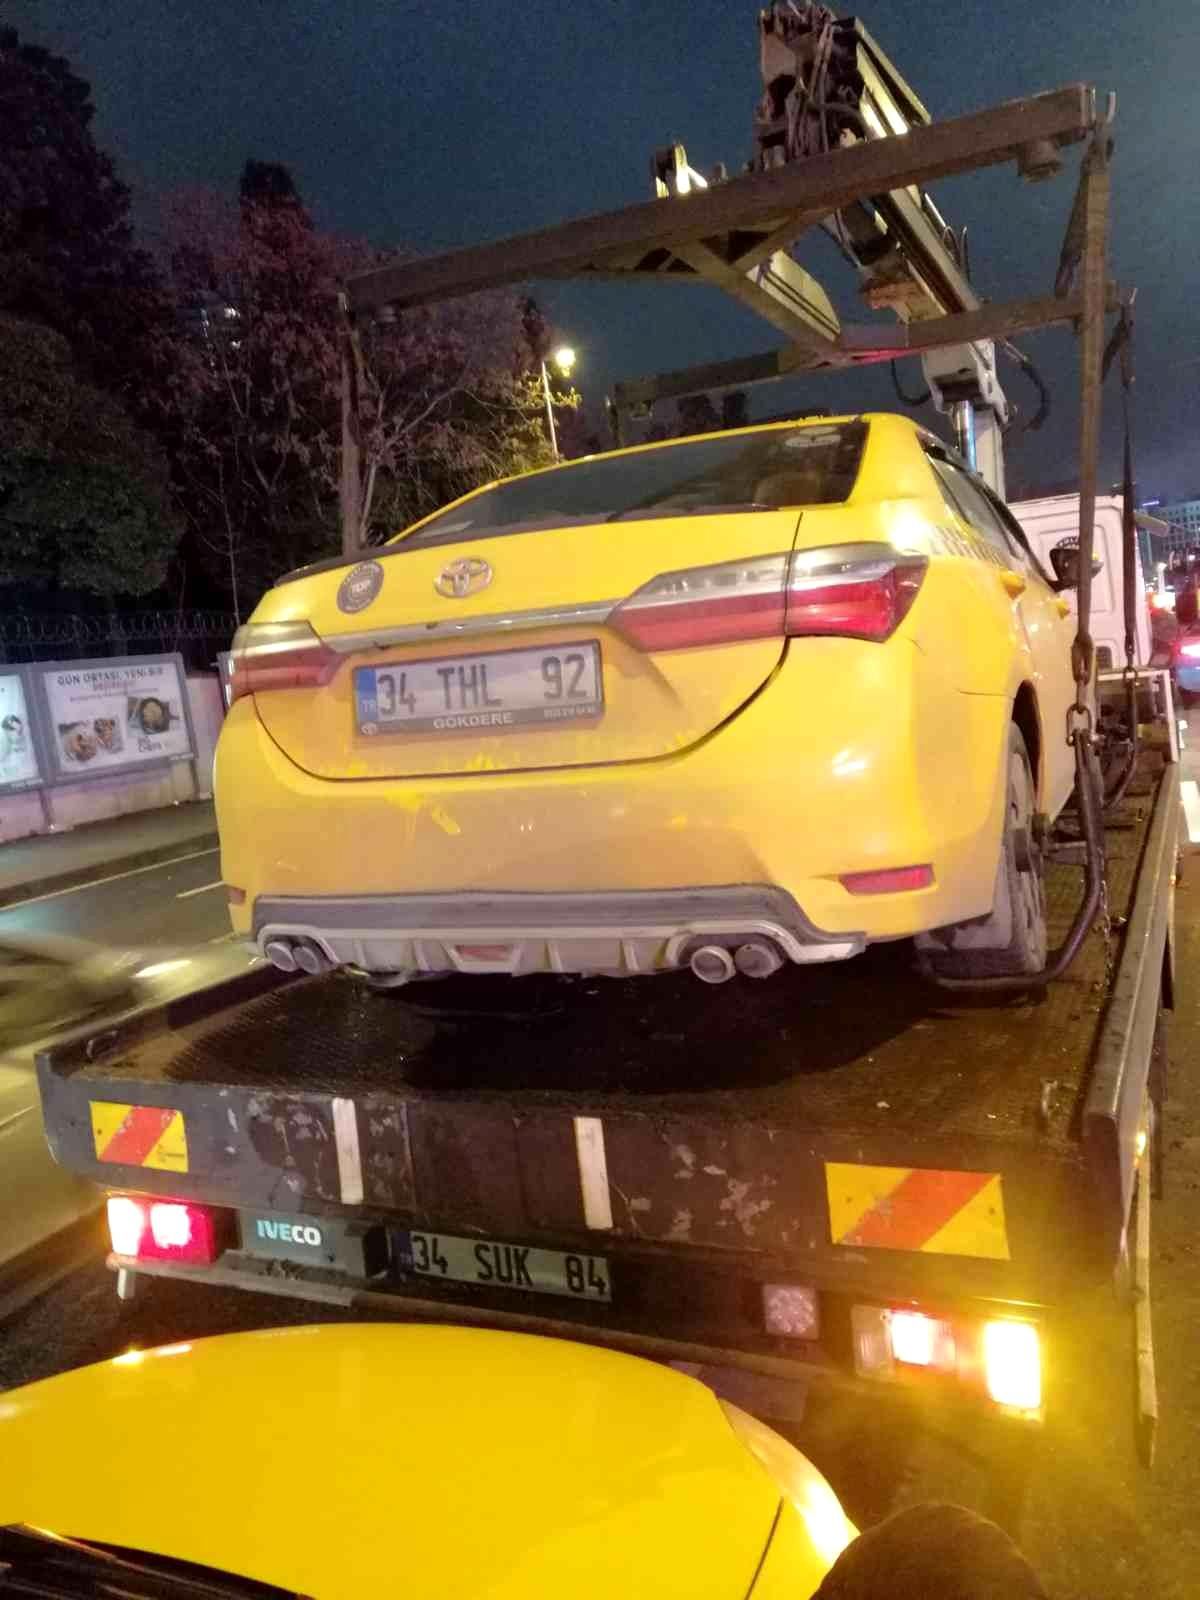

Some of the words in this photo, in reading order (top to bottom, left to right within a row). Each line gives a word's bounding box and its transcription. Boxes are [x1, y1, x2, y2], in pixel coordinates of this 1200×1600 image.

[377, 672, 417, 716] 34
[437, 663, 504, 712] THL
[541, 653, 588, 700] 92
[256, 1219, 321, 1246] IVECO
[412, 1235, 448, 1274] 34
[473, 1243, 533, 1287] SUK
[564, 1255, 606, 1295] 84
